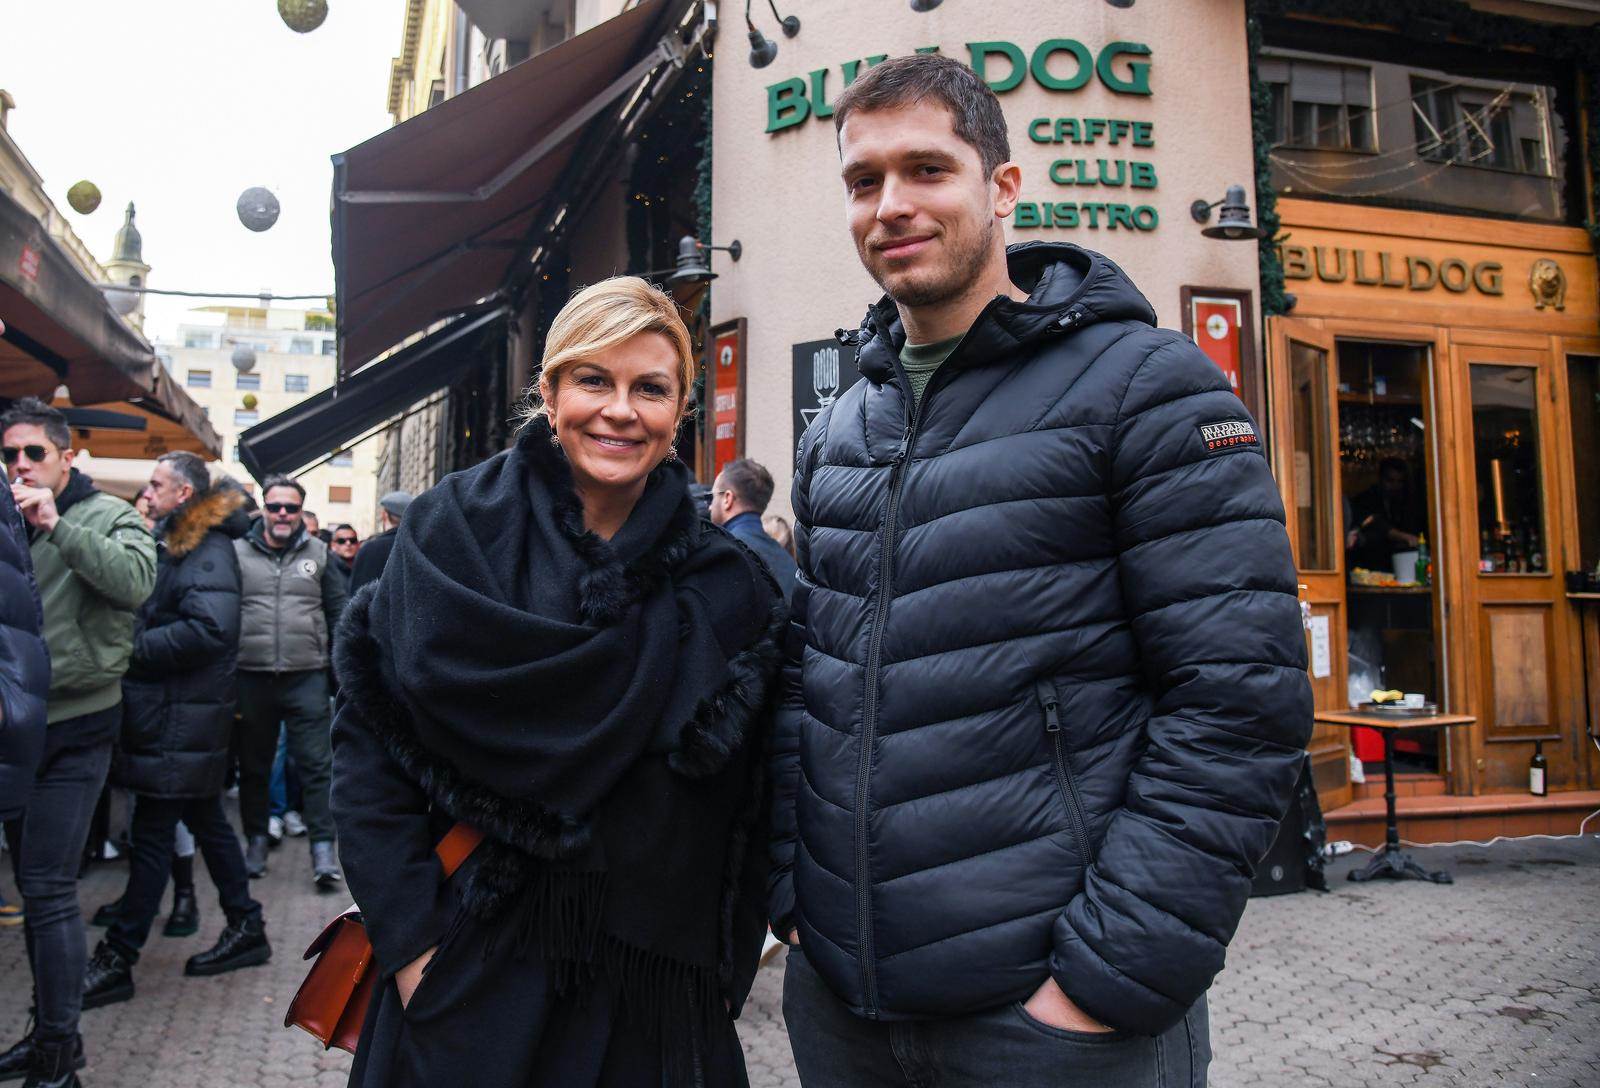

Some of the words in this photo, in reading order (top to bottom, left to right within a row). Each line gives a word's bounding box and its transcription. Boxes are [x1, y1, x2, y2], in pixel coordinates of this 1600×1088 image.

[765, 39, 1152, 133] BUDOG
[1028, 118, 1155, 147] CAFFE
[1049, 159, 1158, 188] CLUB
[1013, 202, 1160, 231] BISTRO
[1279, 245, 1503, 295] BULLDOG
